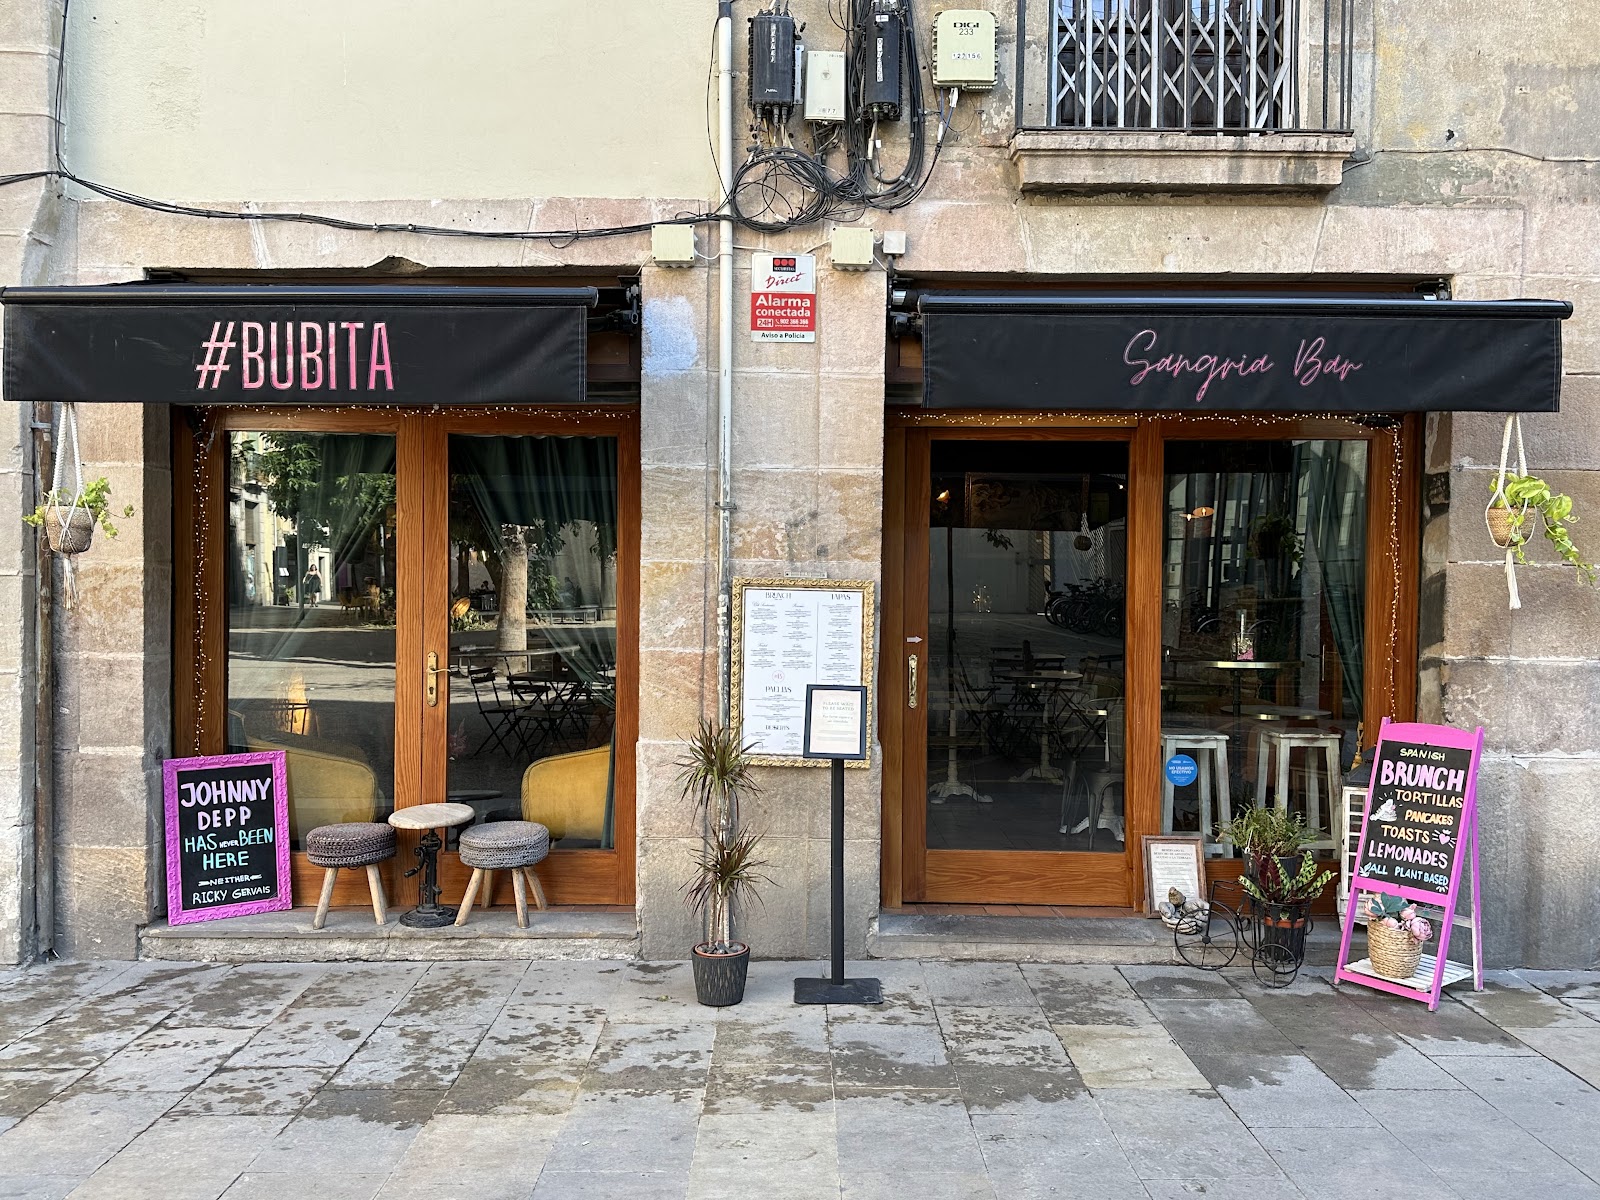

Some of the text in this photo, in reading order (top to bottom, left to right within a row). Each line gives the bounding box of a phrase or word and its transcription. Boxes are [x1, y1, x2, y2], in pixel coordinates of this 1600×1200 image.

[765, 272, 806, 289] Direct
[756, 294, 810, 307] Alarma
[756, 307, 810, 316] conectada
[758, 319, 773, 327] 24H
[195, 321, 394, 390] #BUBITA
[1123, 329, 1363, 402] Sangria Bar
[1400, 748, 1445, 762] SPANISH
[1380, 759, 1465, 793] BRUNCH
[180, 777, 271, 807] JOHNNY
[1395, 788, 1464, 809] TORTILLAS
[197, 805, 252, 831] DEPP
[1404, 809, 1454, 826] PANCAKES
[184, 827, 274, 853] HAS NEVER BEEN
[1381, 824, 1430, 844] TOASTS
[202, 851, 250, 871] HERE
[1368, 840, 1448, 869] LEMONADES
[1368, 865, 1388, 875] ALL
[209, 875, 250, 886] NEITHER
[192, 885, 271, 905] RICKY GERVAIS
